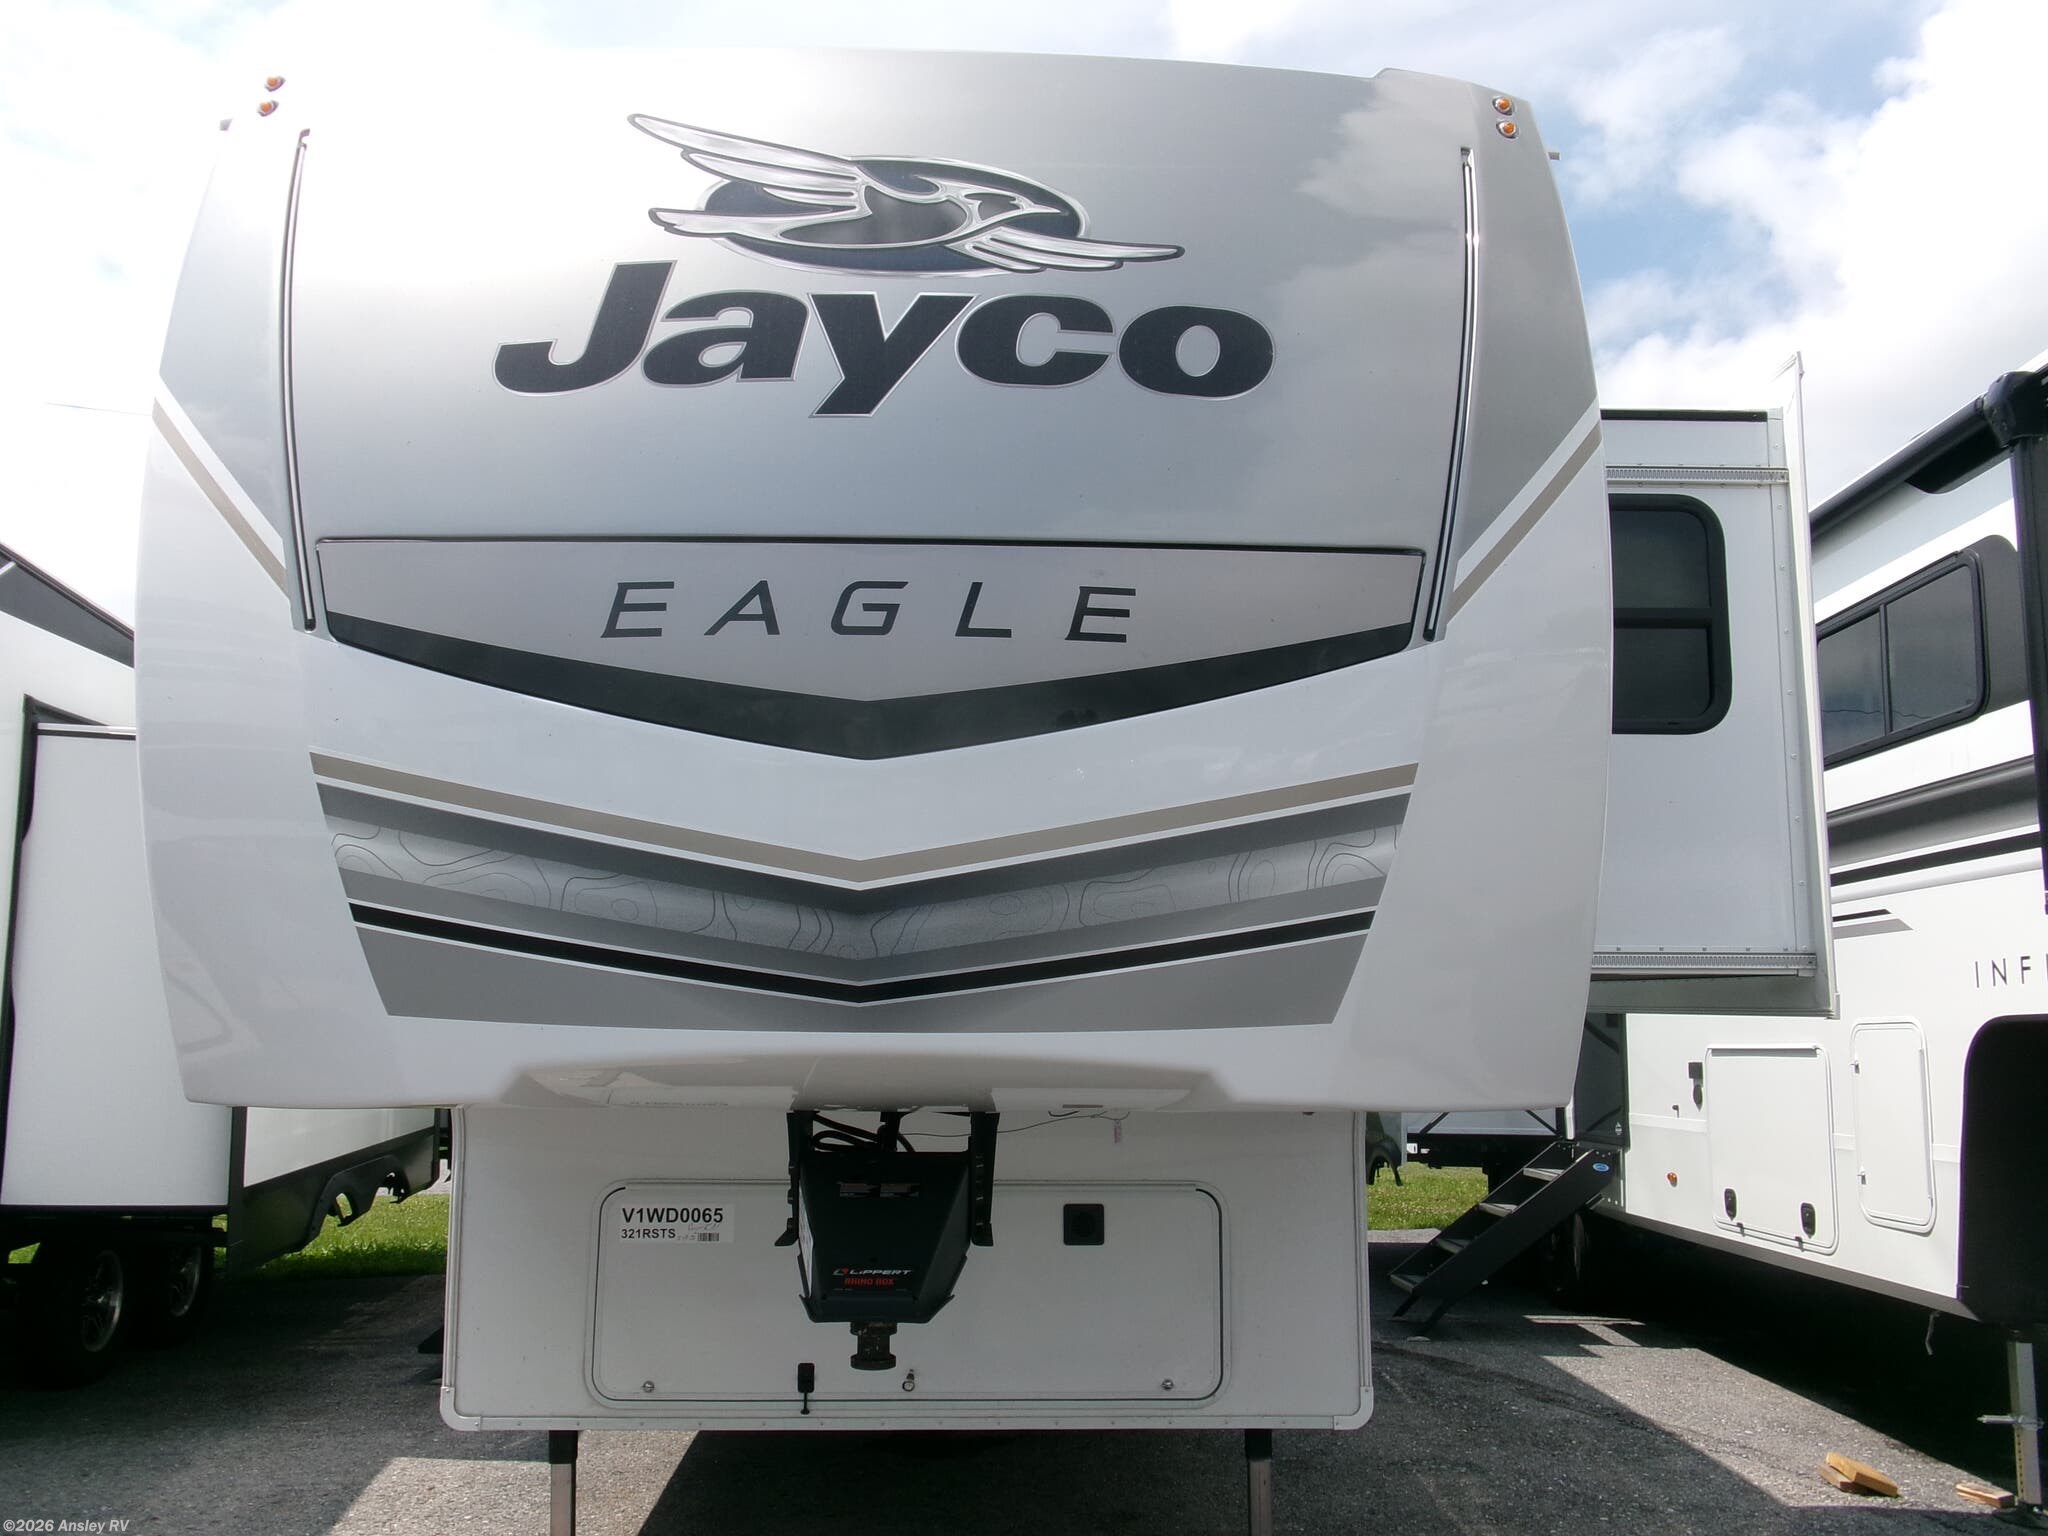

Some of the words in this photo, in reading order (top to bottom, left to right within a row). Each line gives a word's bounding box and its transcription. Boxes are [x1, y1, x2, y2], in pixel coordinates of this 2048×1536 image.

[493, 261, 1274, 418] Jayco
[600, 580, 1136, 642] EAGLE
[620, 1228, 677, 1240] 321RSTS
[621, 1207, 724, 1224] V1WD0065
